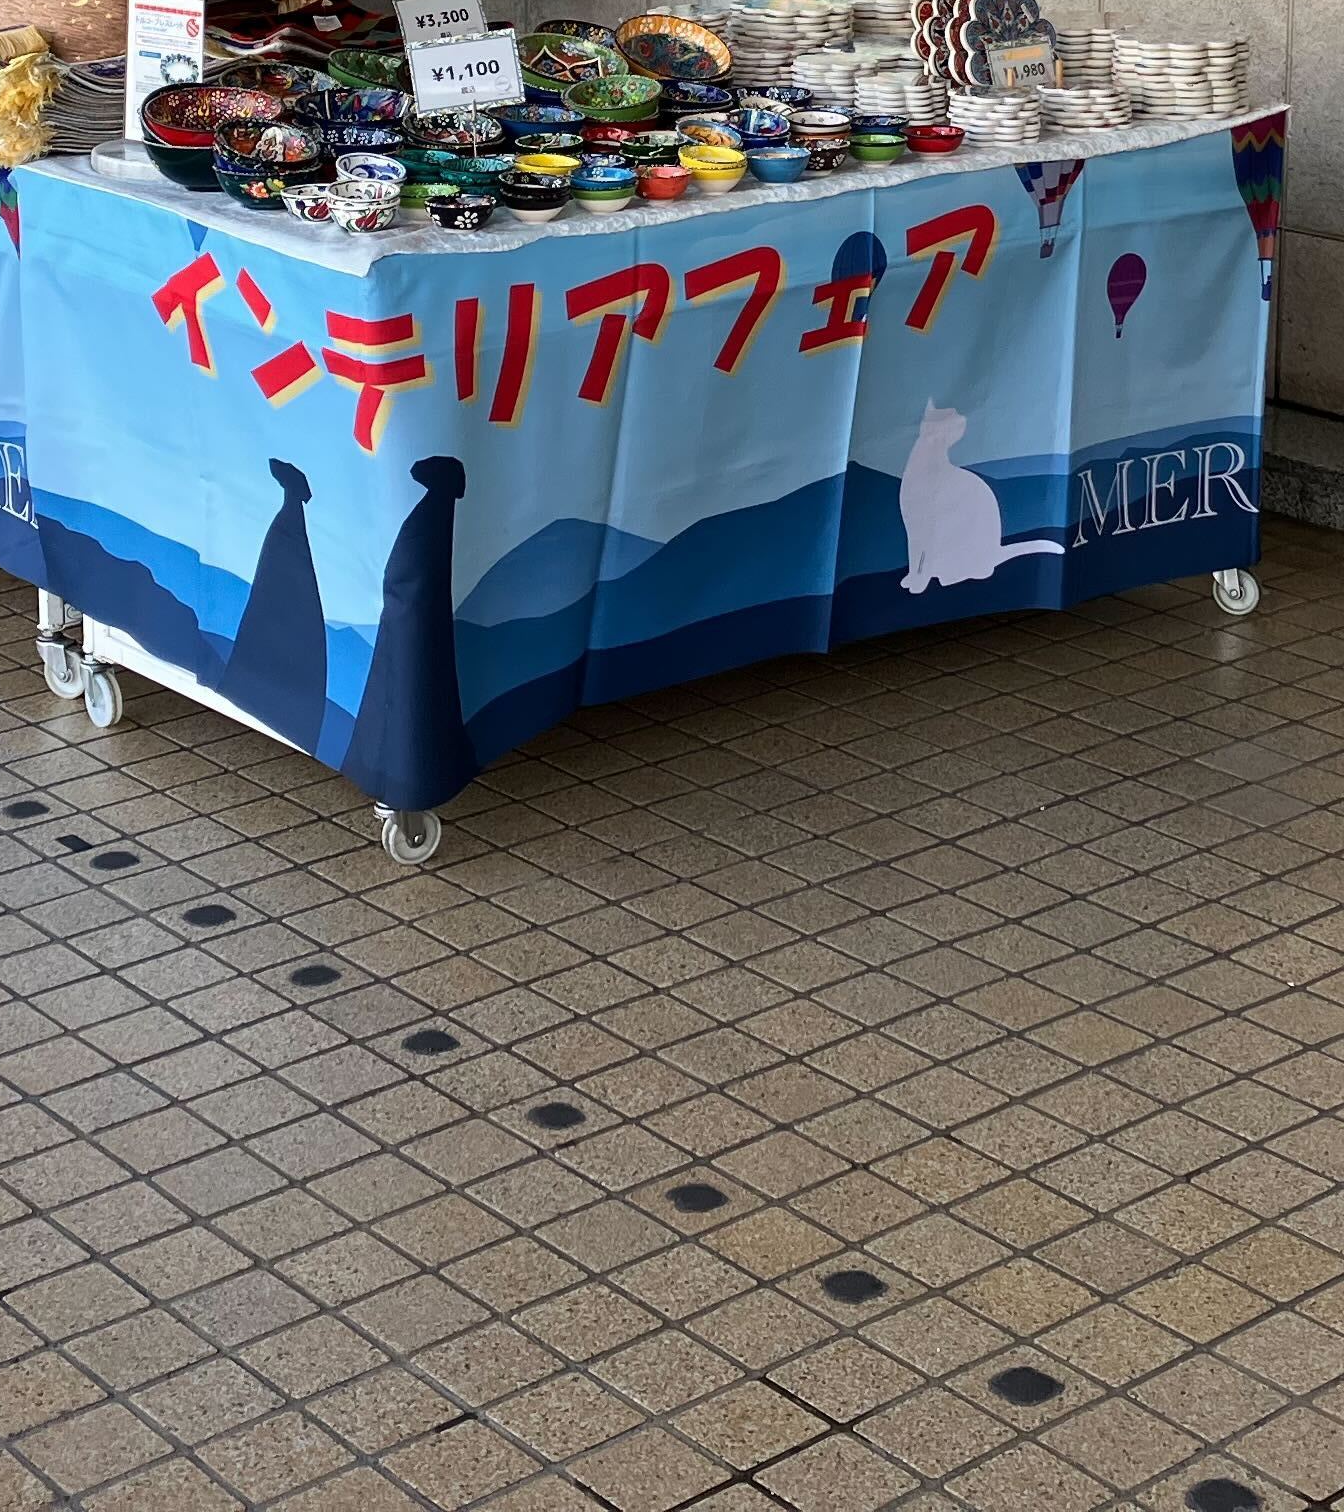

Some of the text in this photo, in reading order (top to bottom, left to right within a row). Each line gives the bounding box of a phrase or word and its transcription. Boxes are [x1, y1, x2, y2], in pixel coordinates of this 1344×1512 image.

[415, 8, 469, 28] ¥3,300
[432, 59, 500, 82] ¥1,100
[150, 203, 1000, 455] インテリアフェア
[1072, 442, 1260, 548] MER
